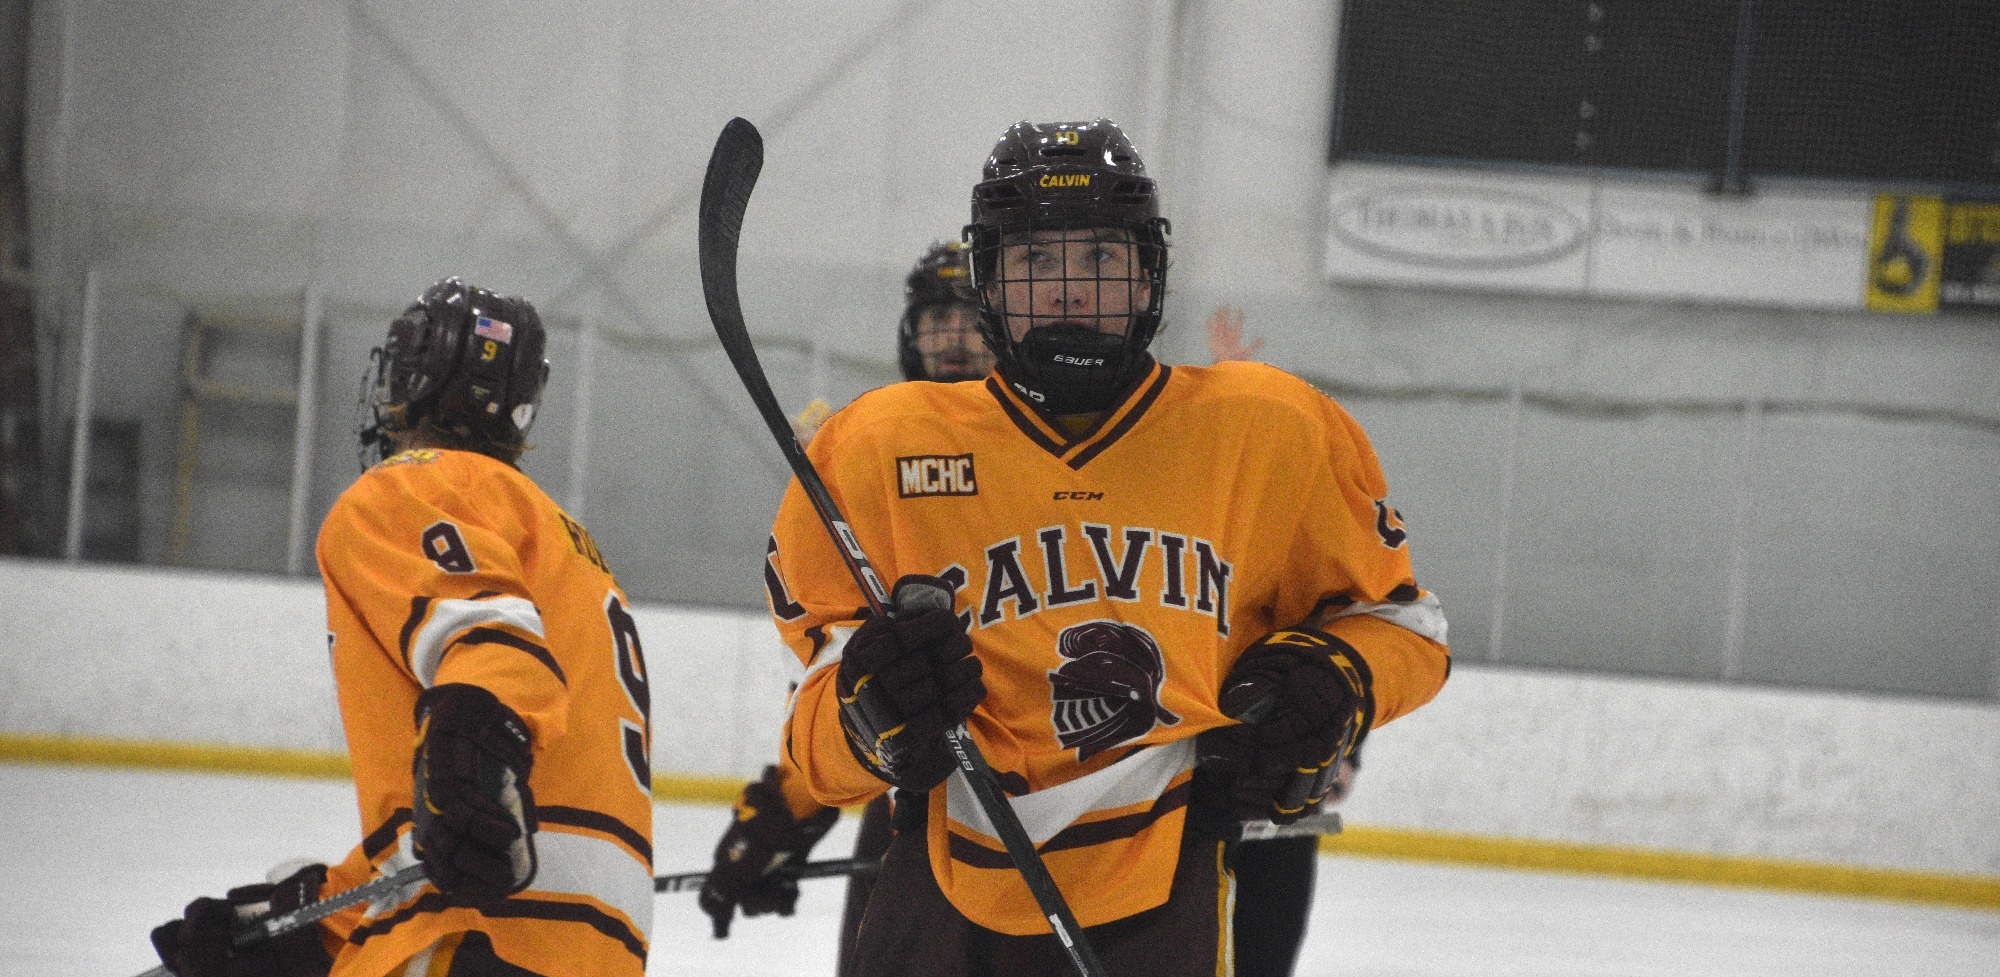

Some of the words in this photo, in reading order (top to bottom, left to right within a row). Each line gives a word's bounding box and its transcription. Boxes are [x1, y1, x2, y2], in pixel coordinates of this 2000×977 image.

[1040, 174, 1091, 188] CALVIN
[481, 340, 499, 360] 9
[1053, 354, 1104, 367] BAUER
[899, 458, 974, 494] MCHC
[1052, 491, 1104, 501] CCM
[421, 520, 477, 573] 9
[945, 729, 974, 771] BAUE
